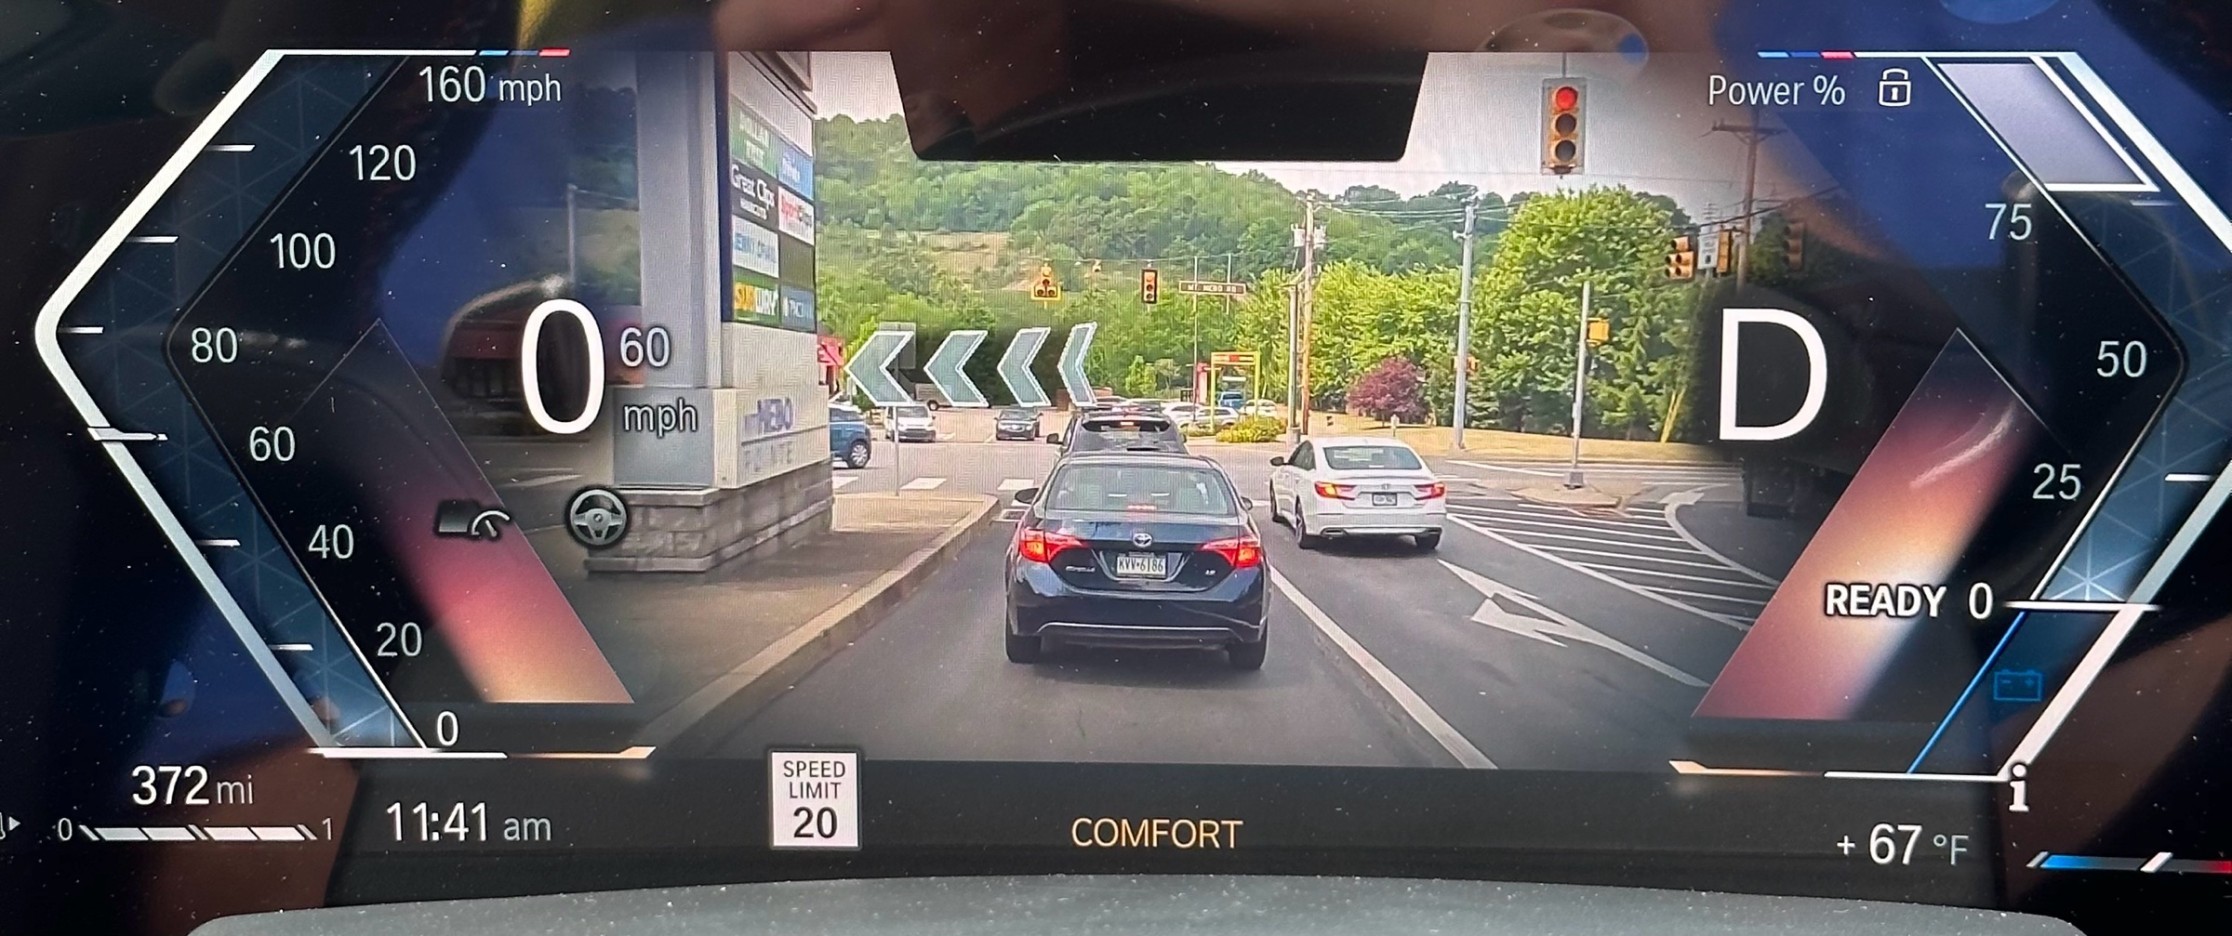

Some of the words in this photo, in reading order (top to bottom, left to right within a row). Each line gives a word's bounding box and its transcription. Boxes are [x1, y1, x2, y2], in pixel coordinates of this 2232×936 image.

[420, 66, 485, 102] 160
[500, 74, 562, 103] mph
[1708, 75, 1804, 106] Power
[1813, 76, 1846, 106] %
[350, 145, 416, 181] 120
[731, 165, 756, 198] Great
[1985, 203, 2033, 241] 75
[271, 233, 335, 269] 100
[191, 328, 238, 363] 80
[619, 328, 670, 367] 60
[2096, 341, 2147, 378] 50
[522, 299, 605, 434] 0
[1719, 308, 1828, 441] D
[622, 400, 698, 438] mph
[249, 427, 295, 462] 60
[2033, 463, 2081, 500] 25
[308, 525, 354, 559] 40
[1826, 585, 1945, 618] READY
[1968, 583, 1993, 620] 0
[377, 623, 422, 657] 20
[436, 711, 459, 746] 0
[132, 766, 210, 805] 372
[217, 775, 253, 804] mi
[783, 760, 846, 778] SPEED
[789, 781, 841, 799] LIMIT
[57, 818, 72, 841] 0
[322, 818, 332, 840] 1
[387, 803, 488, 842] 11:41
[503, 818, 552, 841] am
[793, 807, 838, 839] 20
[1071, 817, 1244, 849] COMFORT
[1869, 824, 1922, 865] 67
[1933, 834, 1969, 865] °F
